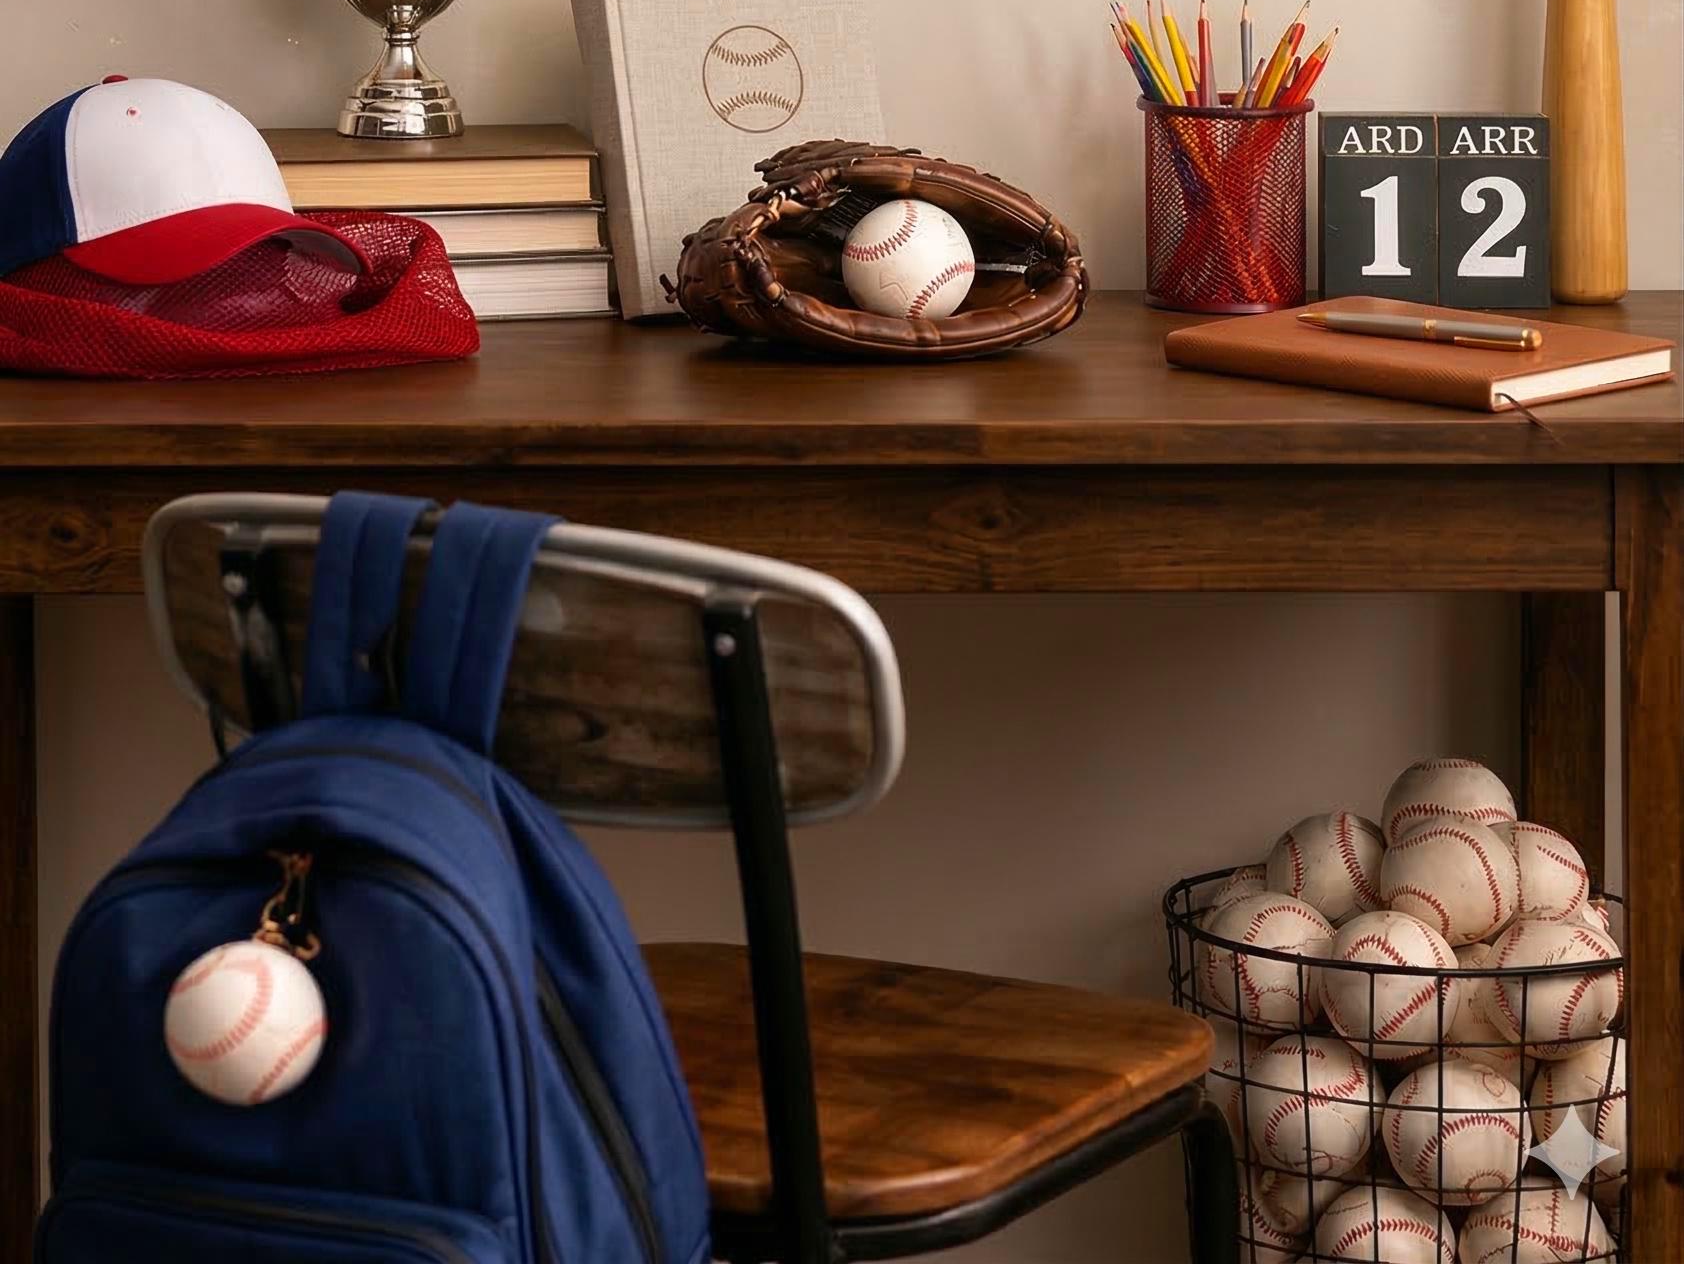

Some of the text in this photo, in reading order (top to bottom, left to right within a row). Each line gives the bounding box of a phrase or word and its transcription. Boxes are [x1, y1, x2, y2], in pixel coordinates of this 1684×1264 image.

[1337, 125, 1538, 155] ARD ARR
[1360, 175, 1527, 277] 1 2
